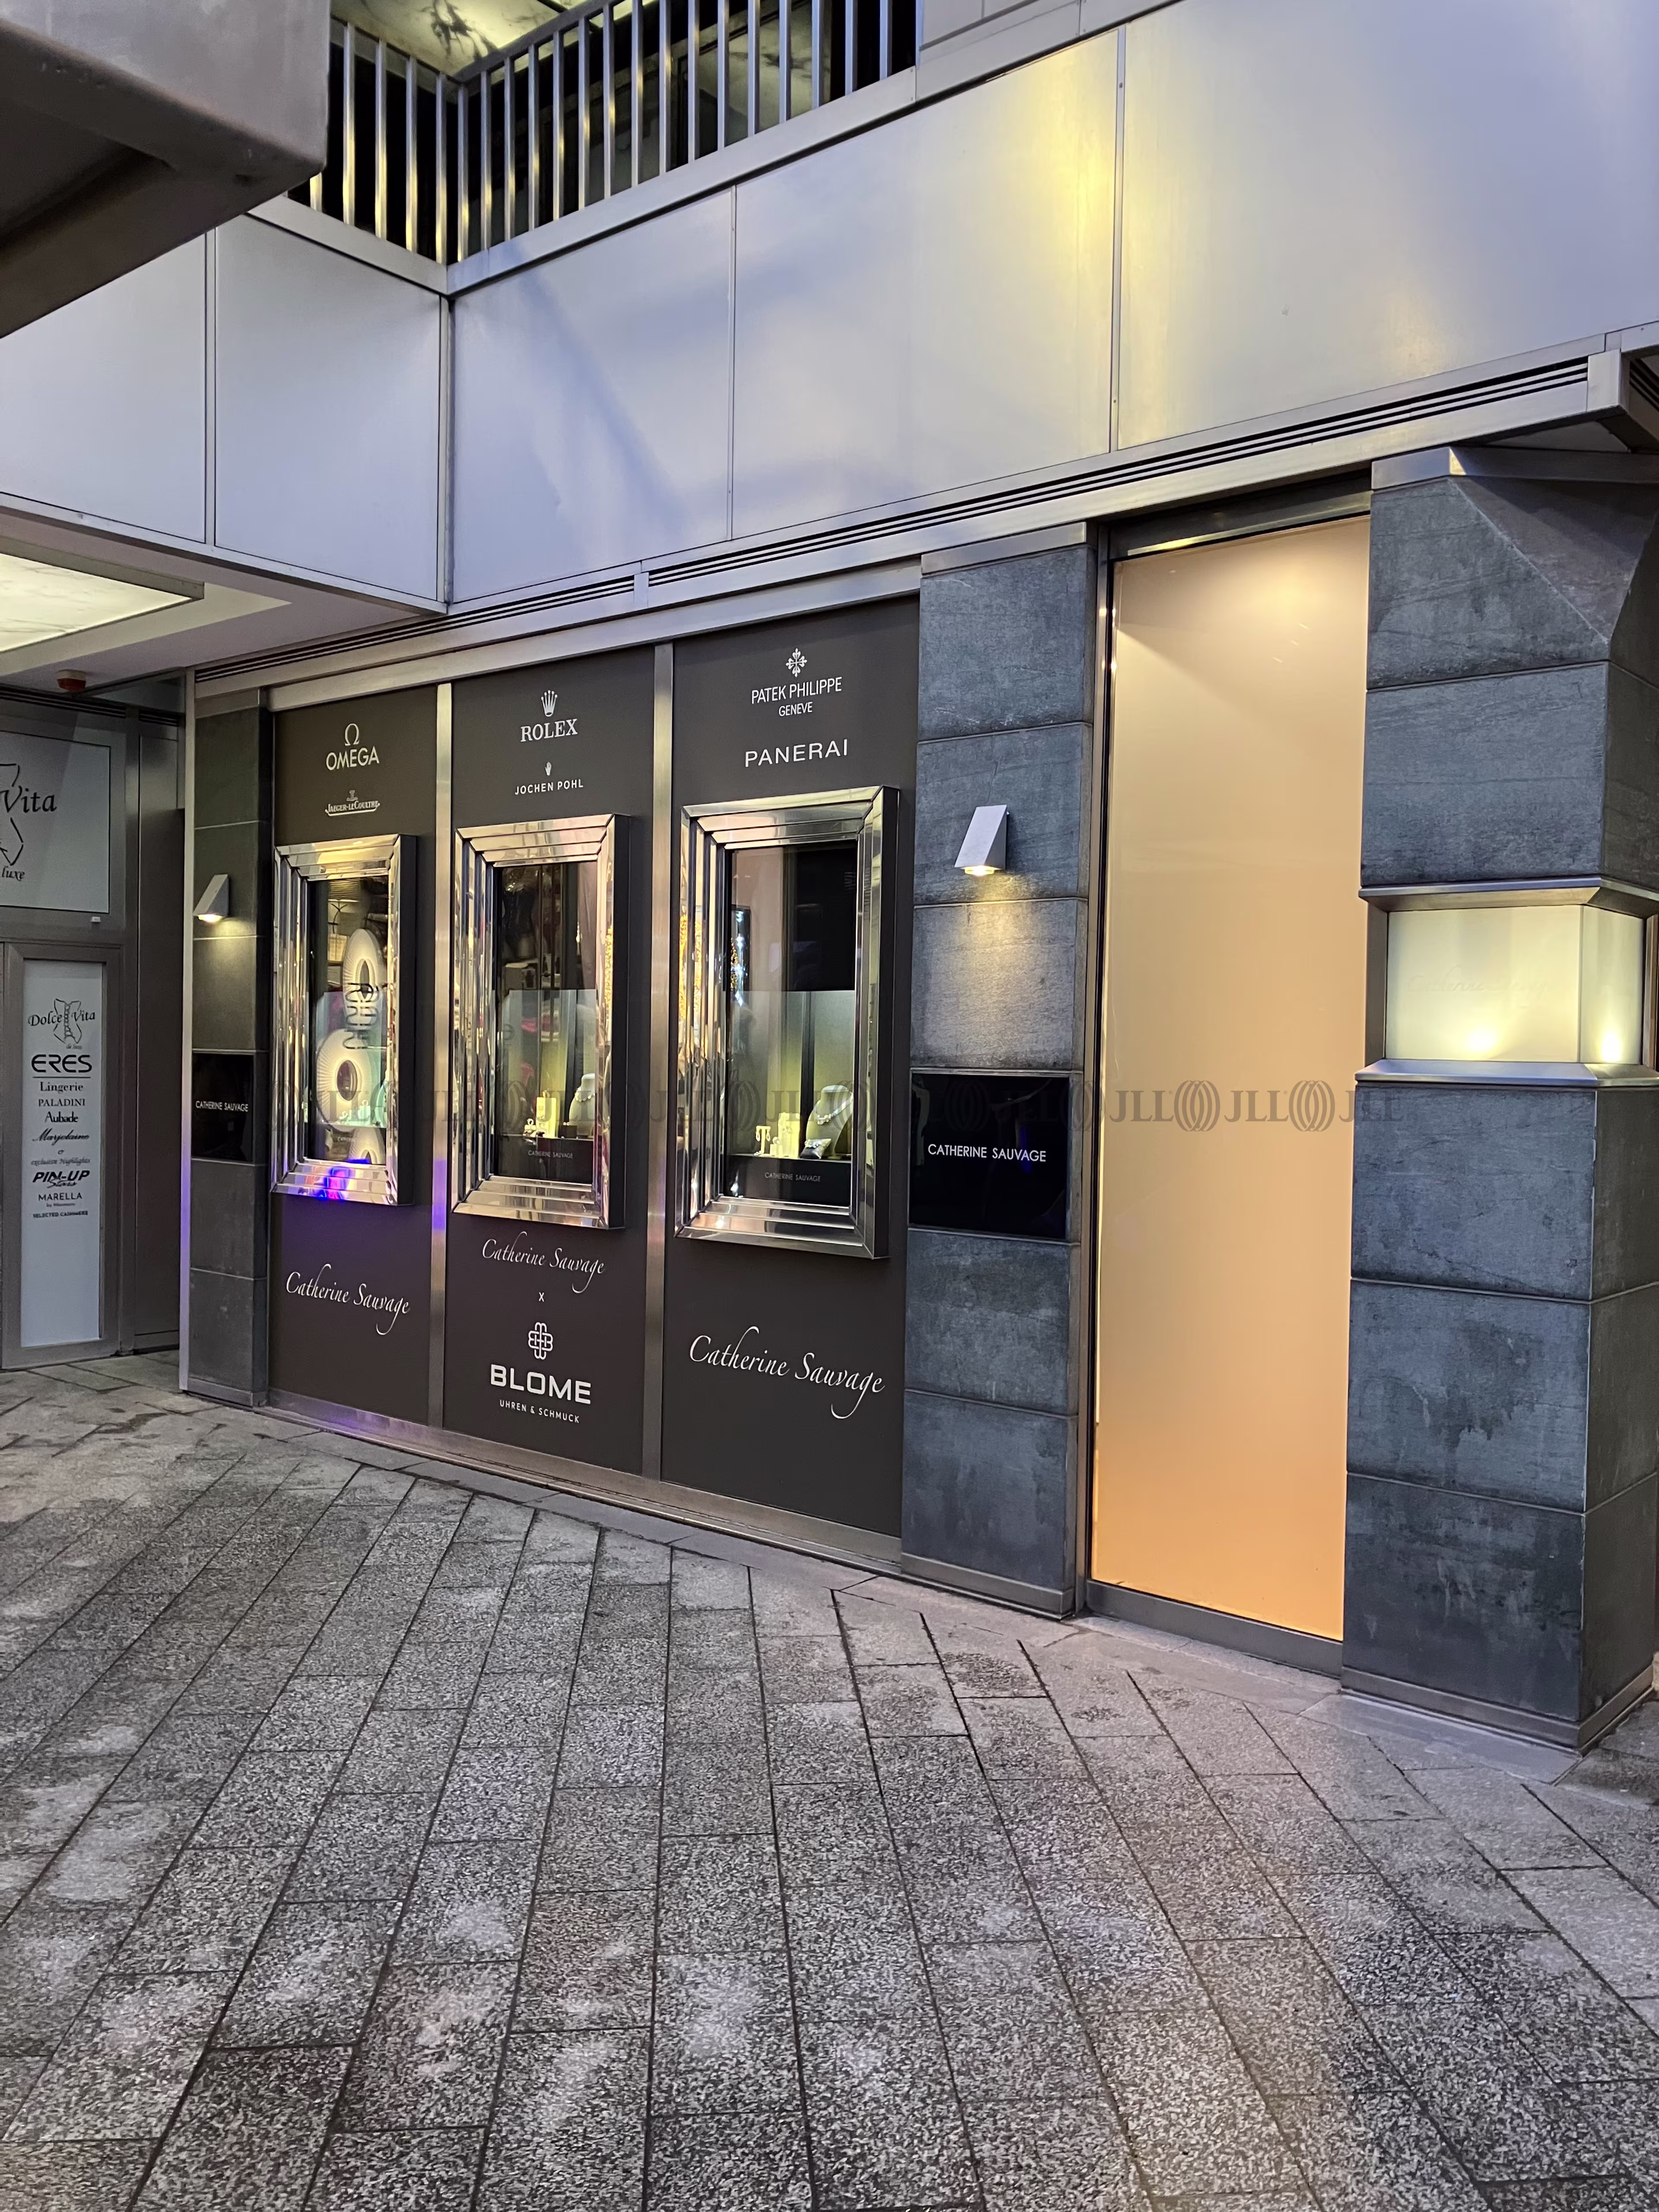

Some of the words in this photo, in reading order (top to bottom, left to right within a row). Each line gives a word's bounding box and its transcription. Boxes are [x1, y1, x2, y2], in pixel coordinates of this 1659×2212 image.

[752, 685, 786, 704] PATEK
[789, 677, 842, 699] PHILIPPE
[779, 701, 813, 717] GENEVE
[520, 718, 578, 742] ROLEX
[326, 746, 380, 771] OMEGA
[745, 739, 848, 768] PANERAI
[515, 782, 553, 795] JOCHEN
[557, 779, 584, 790] POHL
[2, 866, 25, 881] luxe
[28, 1011, 63, 1026] Dolce
[71, 1009, 95, 1023] Vita
[31, 1054, 92, 1073] ERES
[40, 1081, 83, 1093] Lingerie
[38, 1098, 85, 1107] PALADINI
[196, 1101, 222, 1110] CATHERINE
[224, 1103, 248, 1112] SAUVAGE
[44, 1111, 79, 1123] Aubade
[928, 1144, 987, 1158] CATHERINE
[992, 1148, 1046, 1162] SAUVAGE
[32, 1170, 90, 1182] PIN-UP
[764, 1172, 793, 1180] CATHERINE
[38, 1192, 82, 1201] MARELLA
[482, 1231, 546, 1266] Catherine
[550, 1248, 605, 1294] Sauvage
[286, 1263, 350, 1303] Catherine
[353, 1283, 410, 1335] Sauvage
[690, 1326, 790, 1376] Catherine
[795, 1352, 885, 1419] Sauvage
[490, 1364, 591, 1405] BLOME
[499, 1399, 527, 1412] UHREN
[530, 1405, 535, 1414] &
[538, 1407, 579, 1424] SCHMUCK
